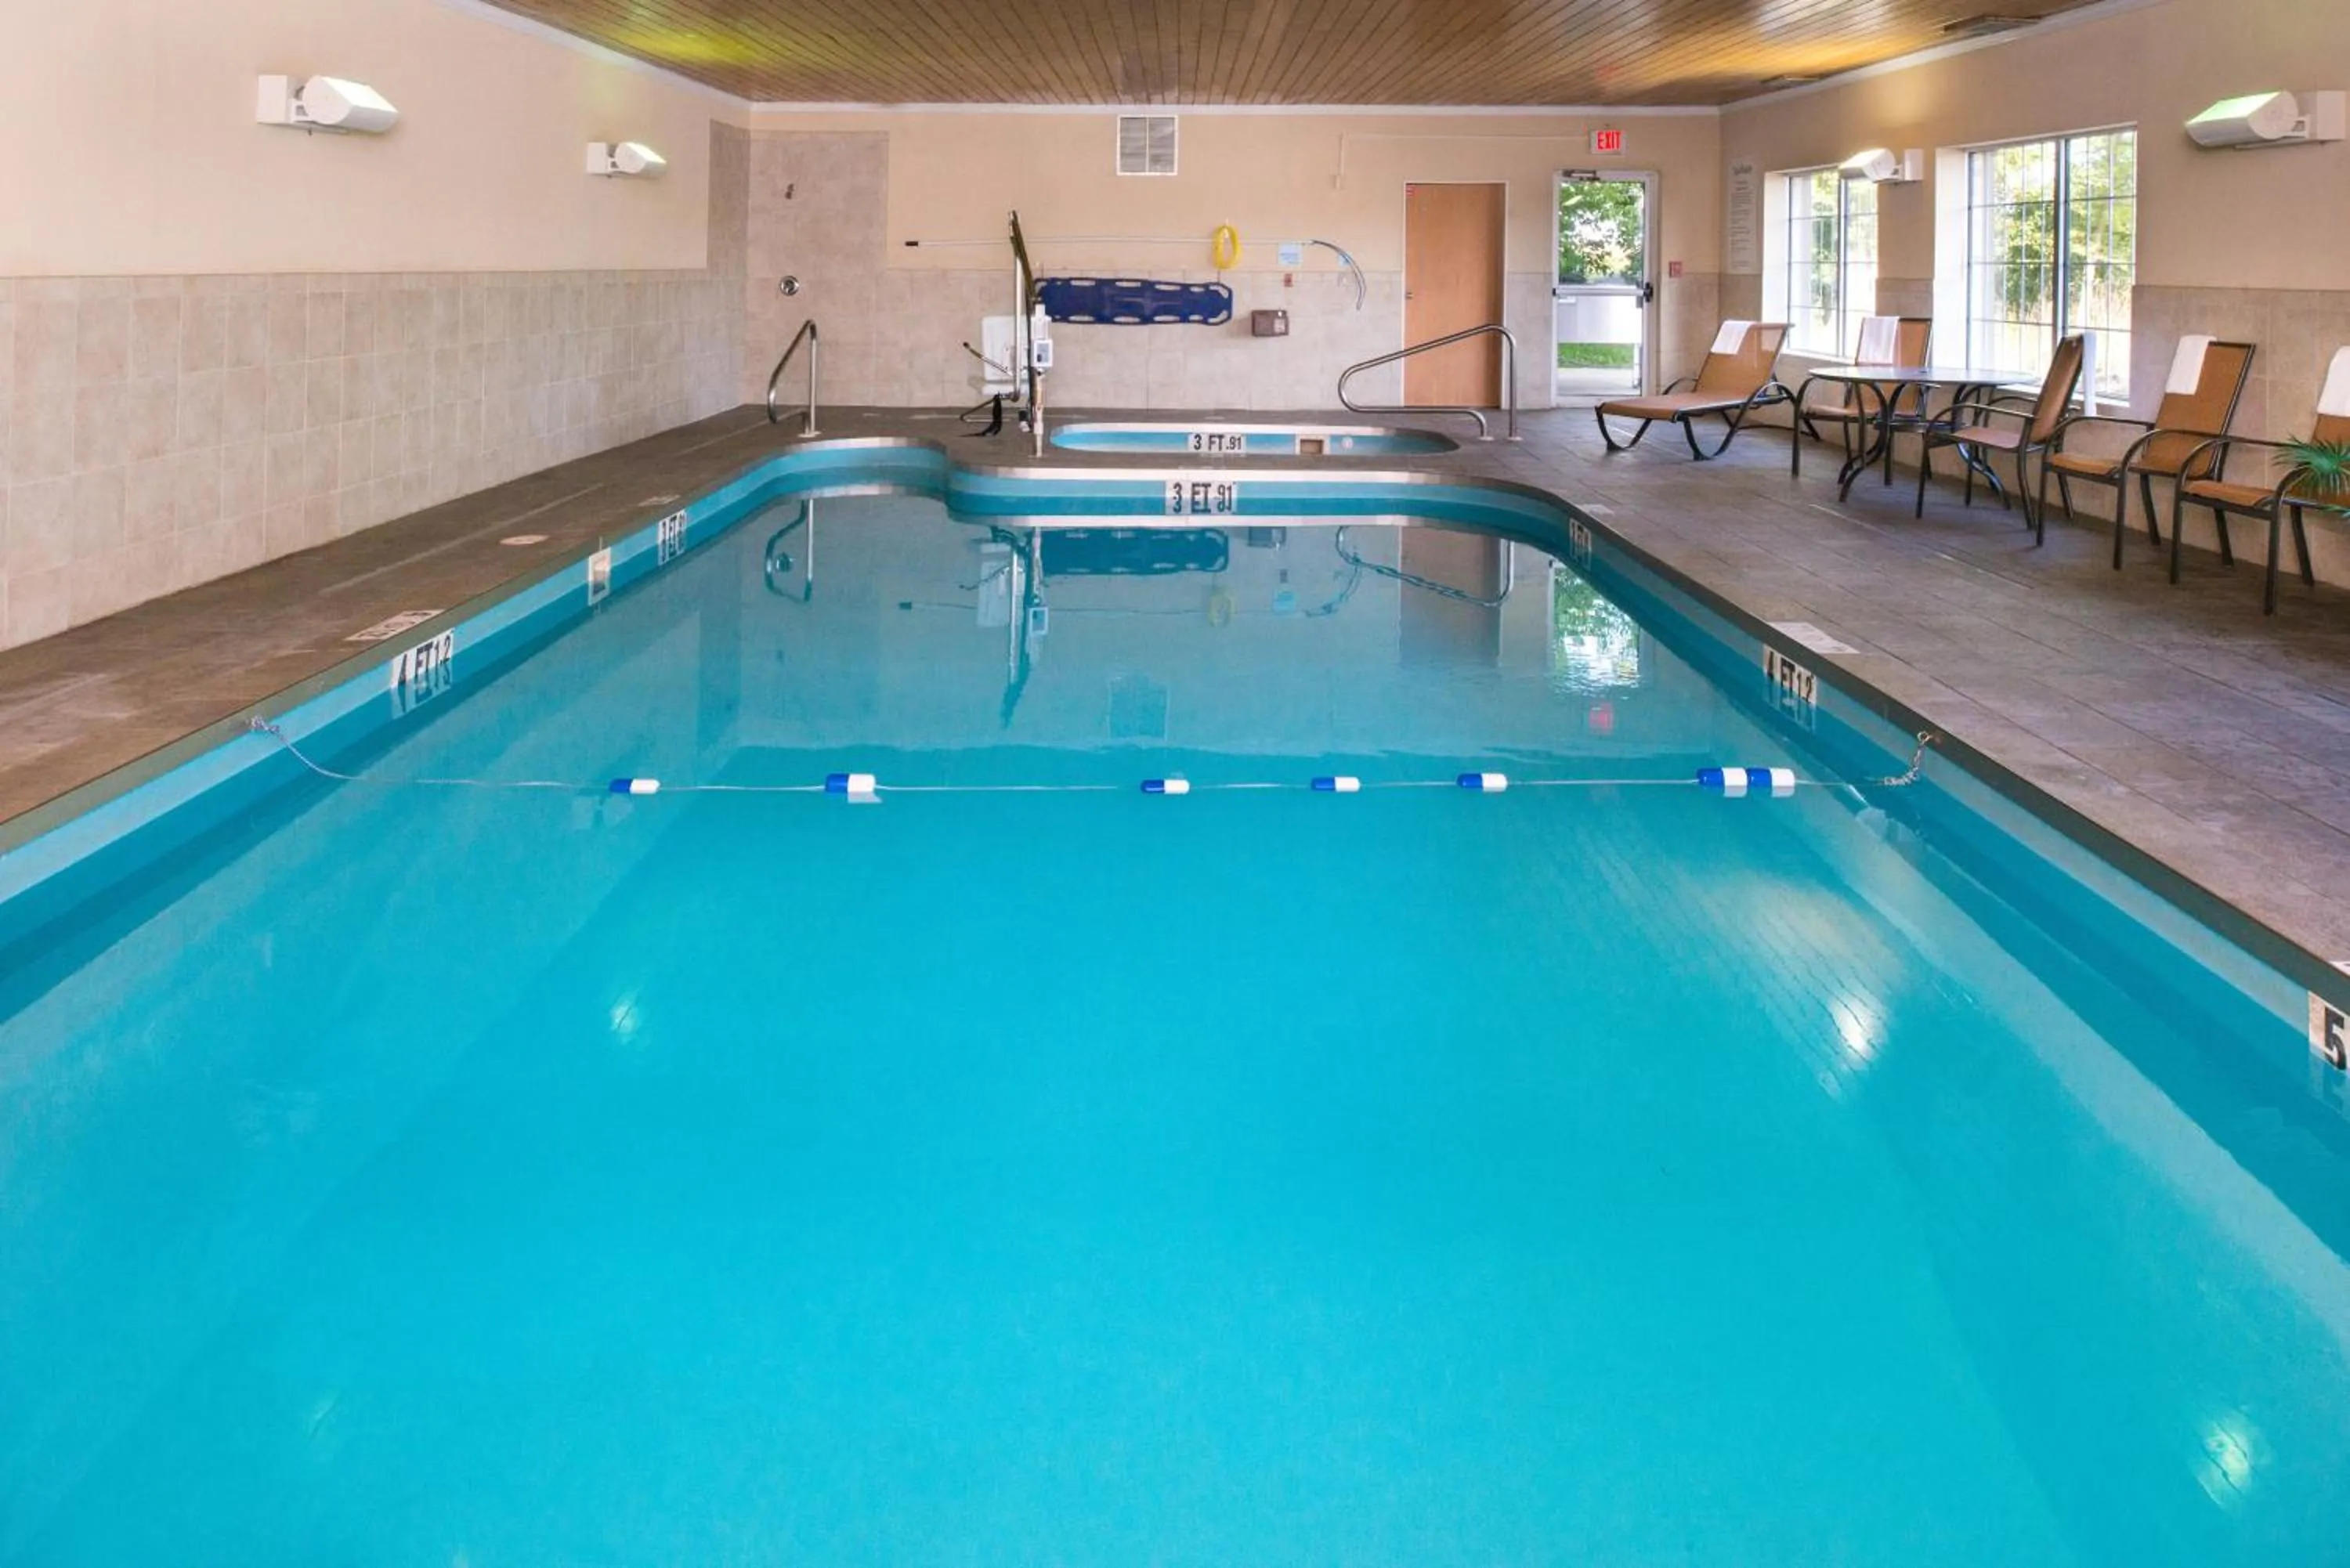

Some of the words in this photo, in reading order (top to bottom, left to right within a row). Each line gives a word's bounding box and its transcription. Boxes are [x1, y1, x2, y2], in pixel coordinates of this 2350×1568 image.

[1597, 130, 1622, 150] EXIT
[1193, 433, 1202, 450] 3
[1208, 433, 1224, 451] FT
[2324, 1006, 2347, 1071] 5
